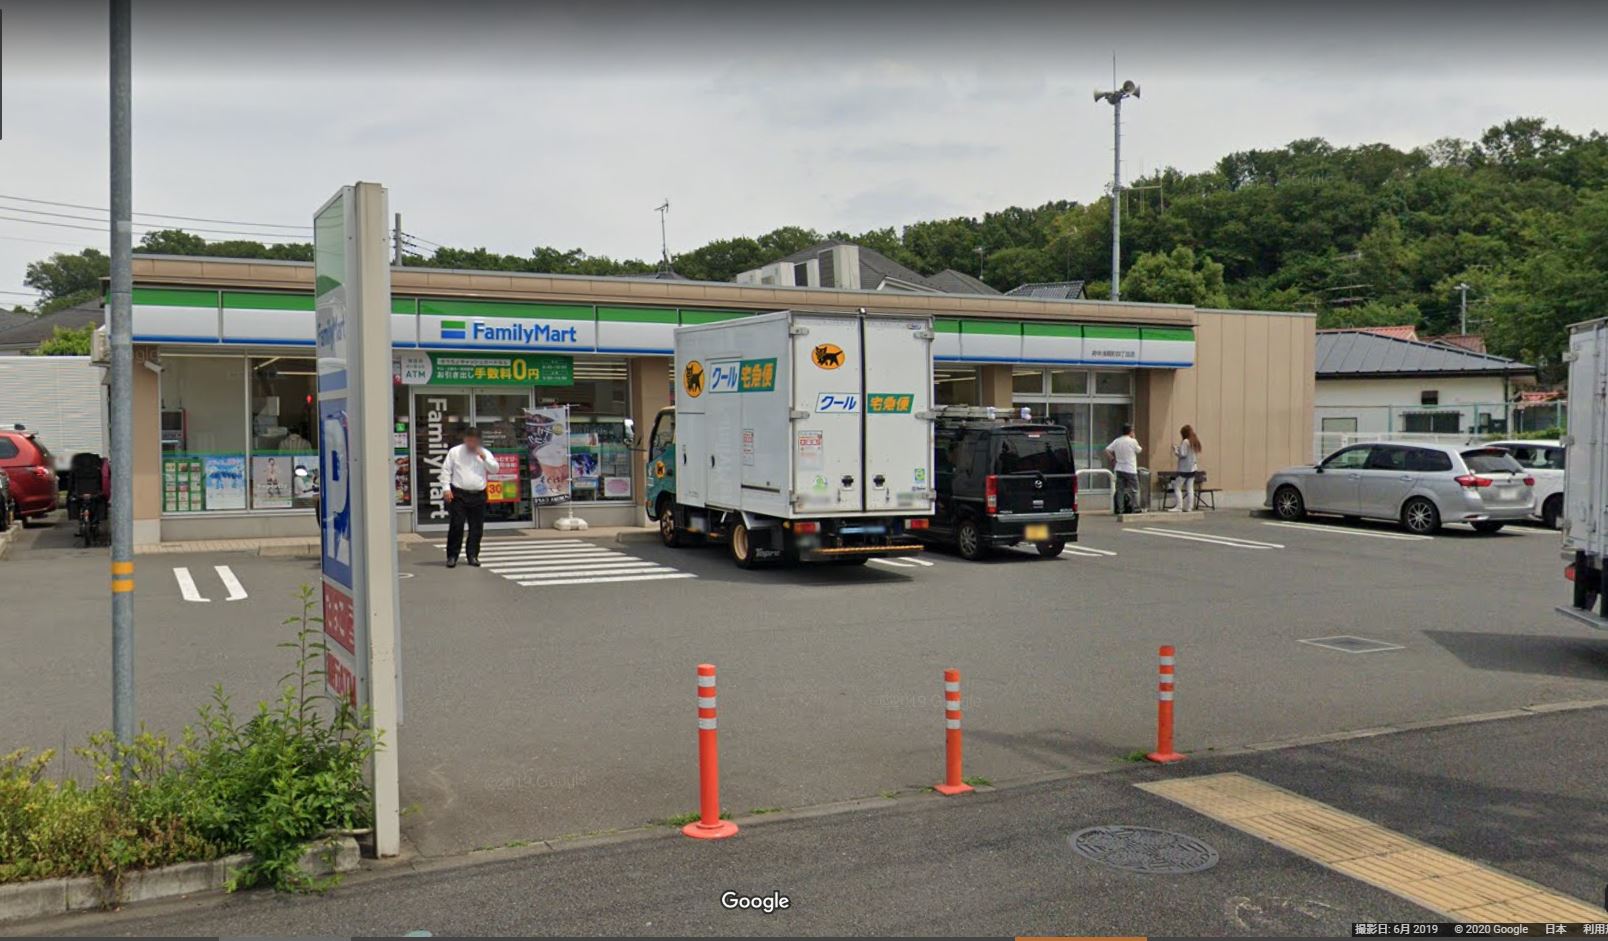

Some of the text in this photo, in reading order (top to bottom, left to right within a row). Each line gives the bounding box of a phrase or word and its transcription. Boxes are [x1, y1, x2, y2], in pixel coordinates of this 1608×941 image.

[472, 322, 577, 344] FamilyMart
[405, 370, 426, 378] ATM
[819, 395, 911, 411] クール 宅急便
